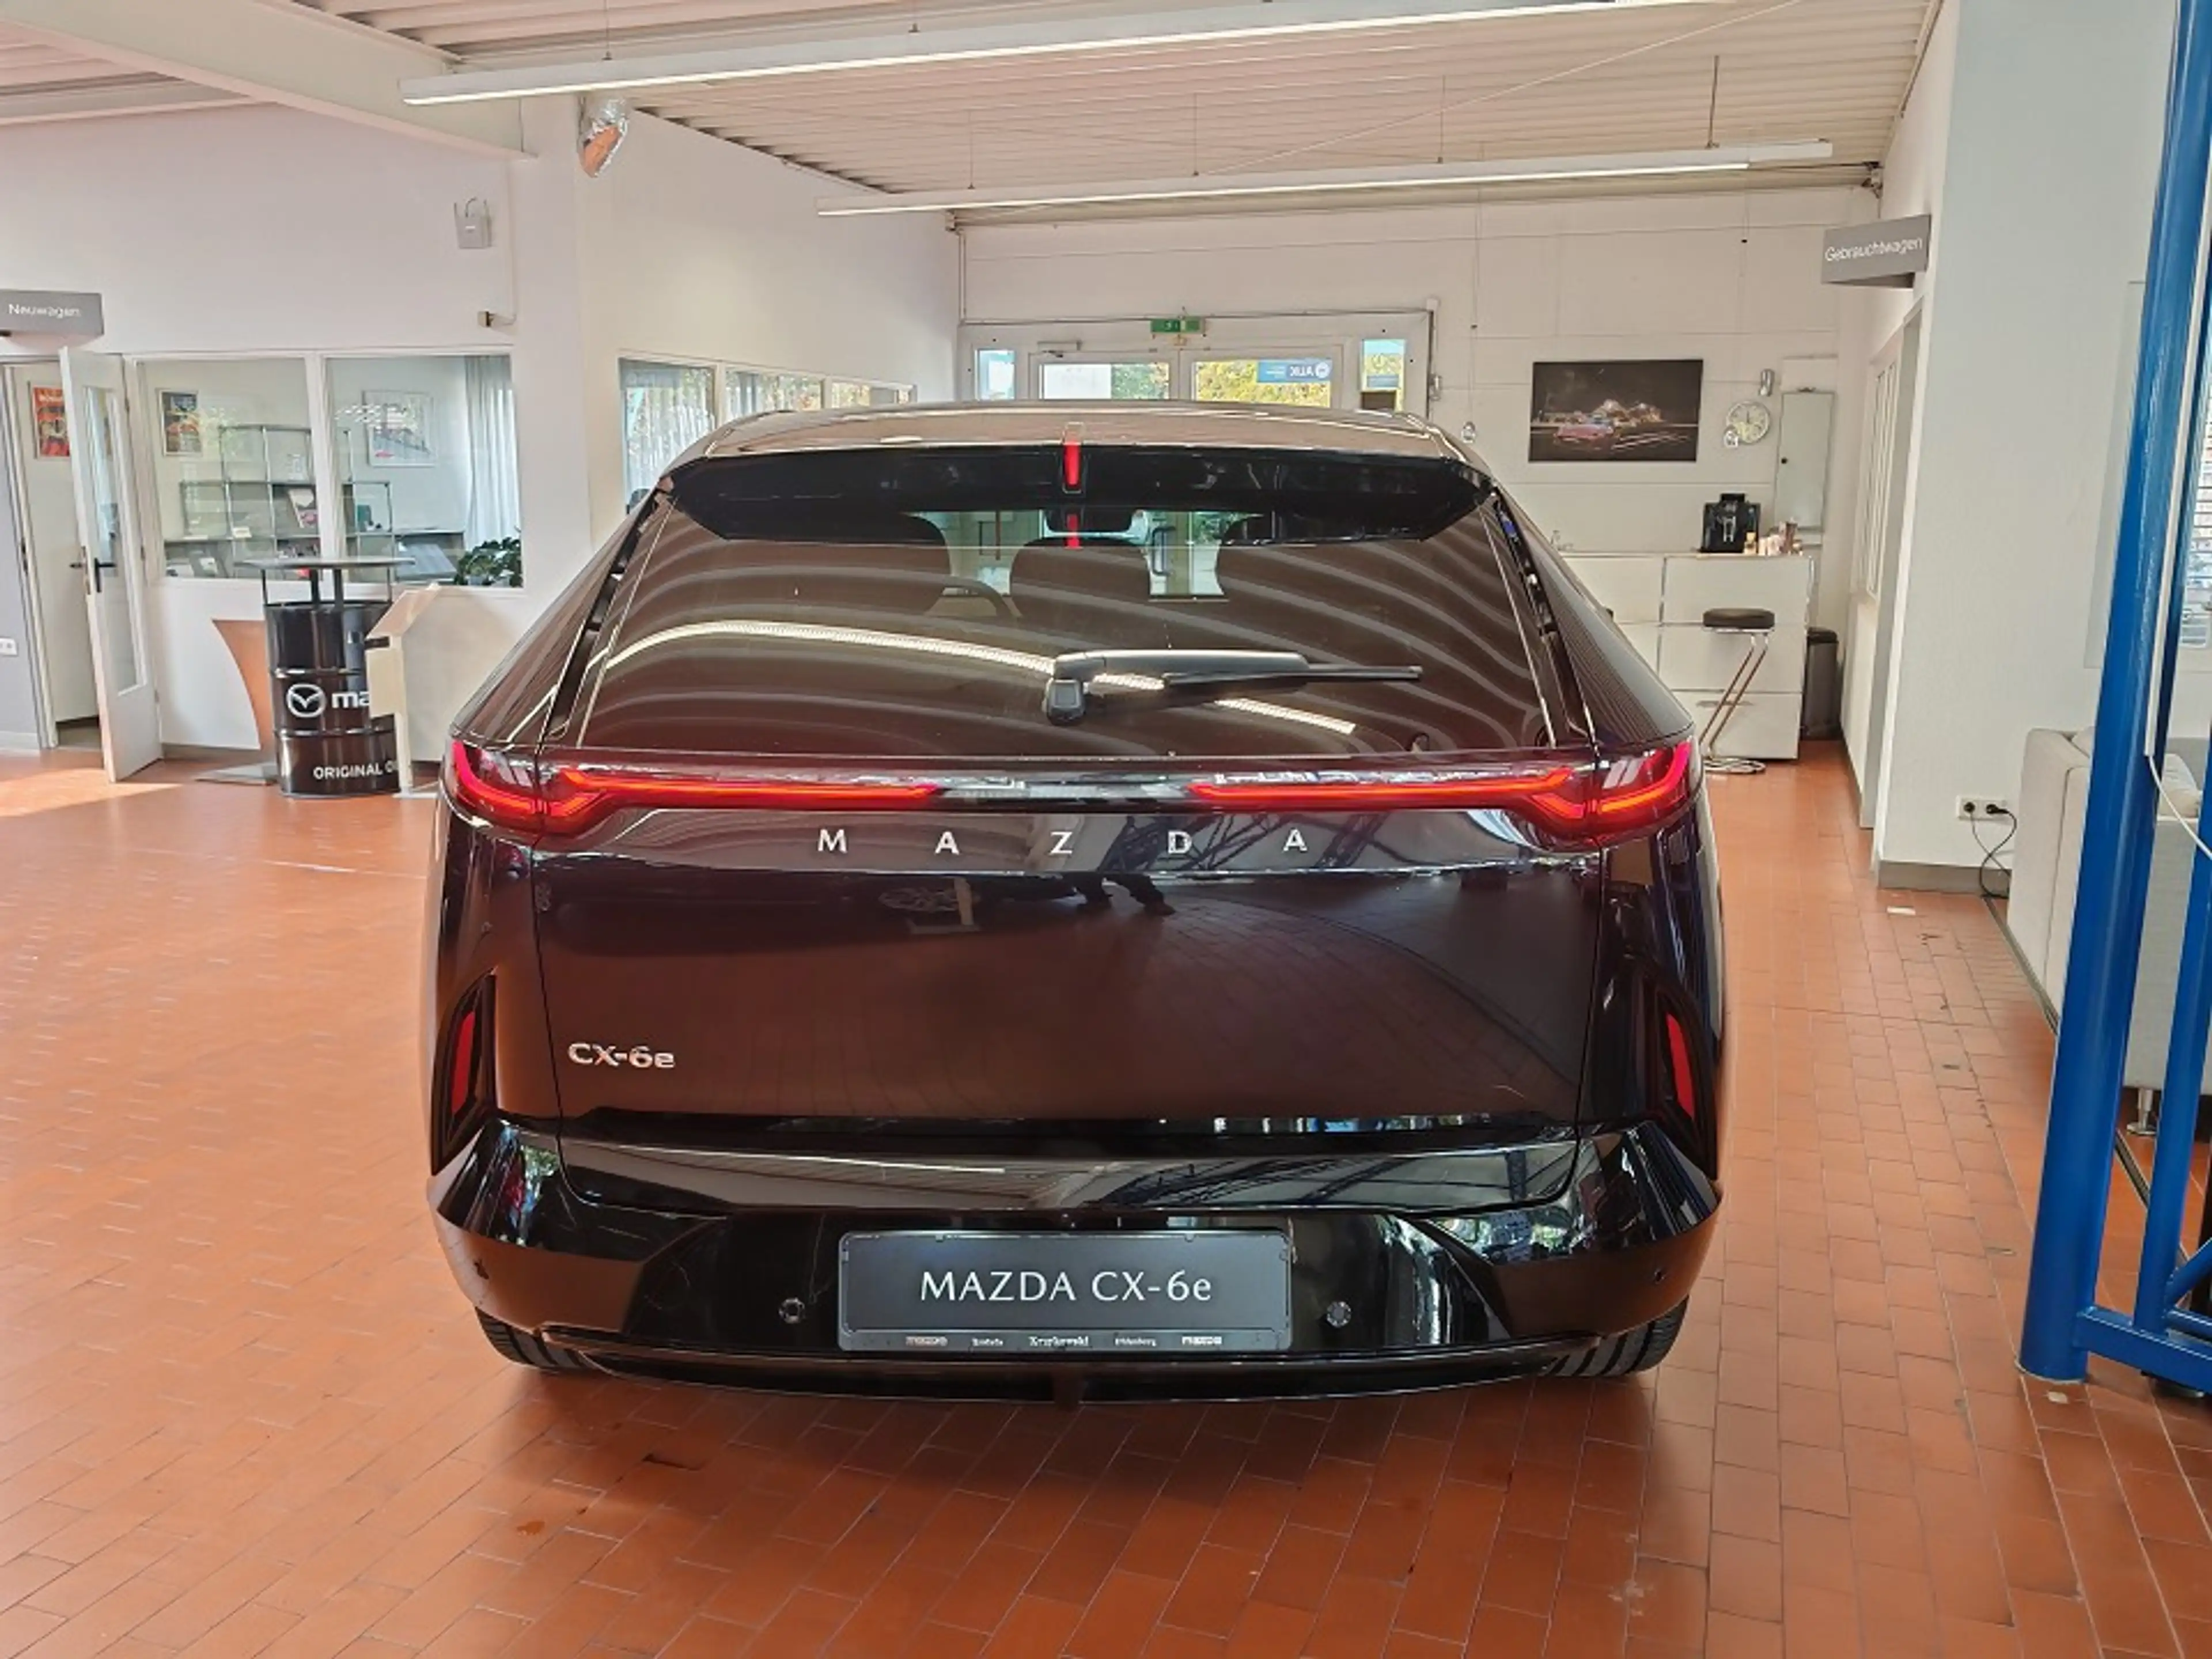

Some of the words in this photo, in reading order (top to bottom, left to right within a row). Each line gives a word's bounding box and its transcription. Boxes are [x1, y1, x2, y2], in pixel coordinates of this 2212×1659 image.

[1824, 237, 1923, 262] Gebrauchtwagen
[313, 762, 383, 779] ORIGINAL
[567, 1042, 675, 1069] CX-6e
[921, 1271, 1077, 1301] MAZDA
[1092, 1270, 1211, 1301] CX-6e
